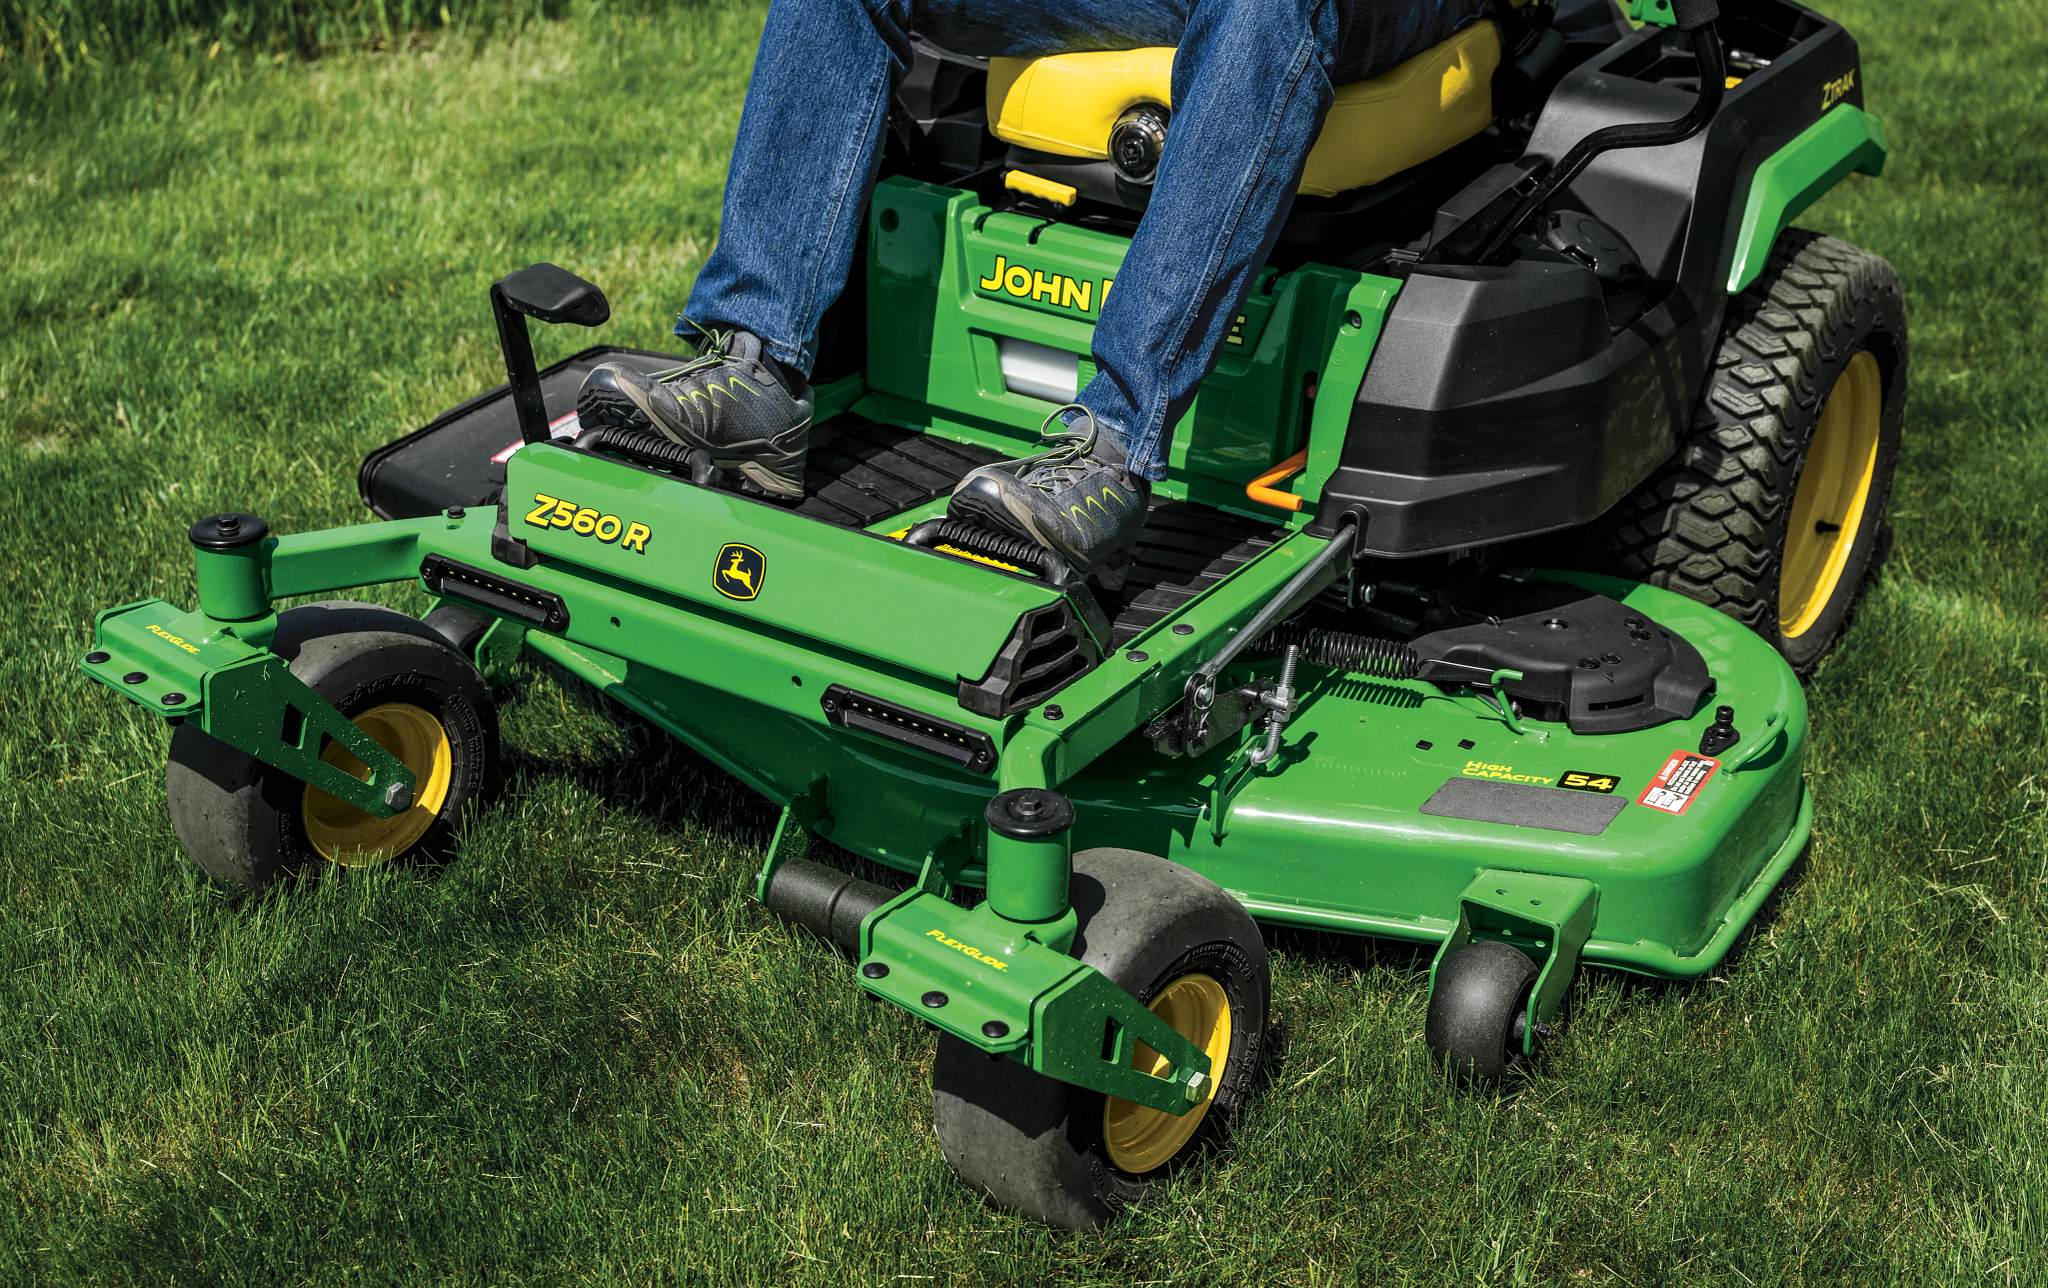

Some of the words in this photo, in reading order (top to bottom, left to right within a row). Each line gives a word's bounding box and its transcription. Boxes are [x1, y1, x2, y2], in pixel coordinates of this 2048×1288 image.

[1821, 68, 1855, 111] ZTRAK
[980, 255, 1092, 312] JOHN
[524, 492, 623, 544] Z560
[621, 521, 652, 555] R
[1462, 768, 1554, 785] CAPACITY
[1465, 760, 1513, 773] HIGH
[1563, 773, 1613, 790] 54
